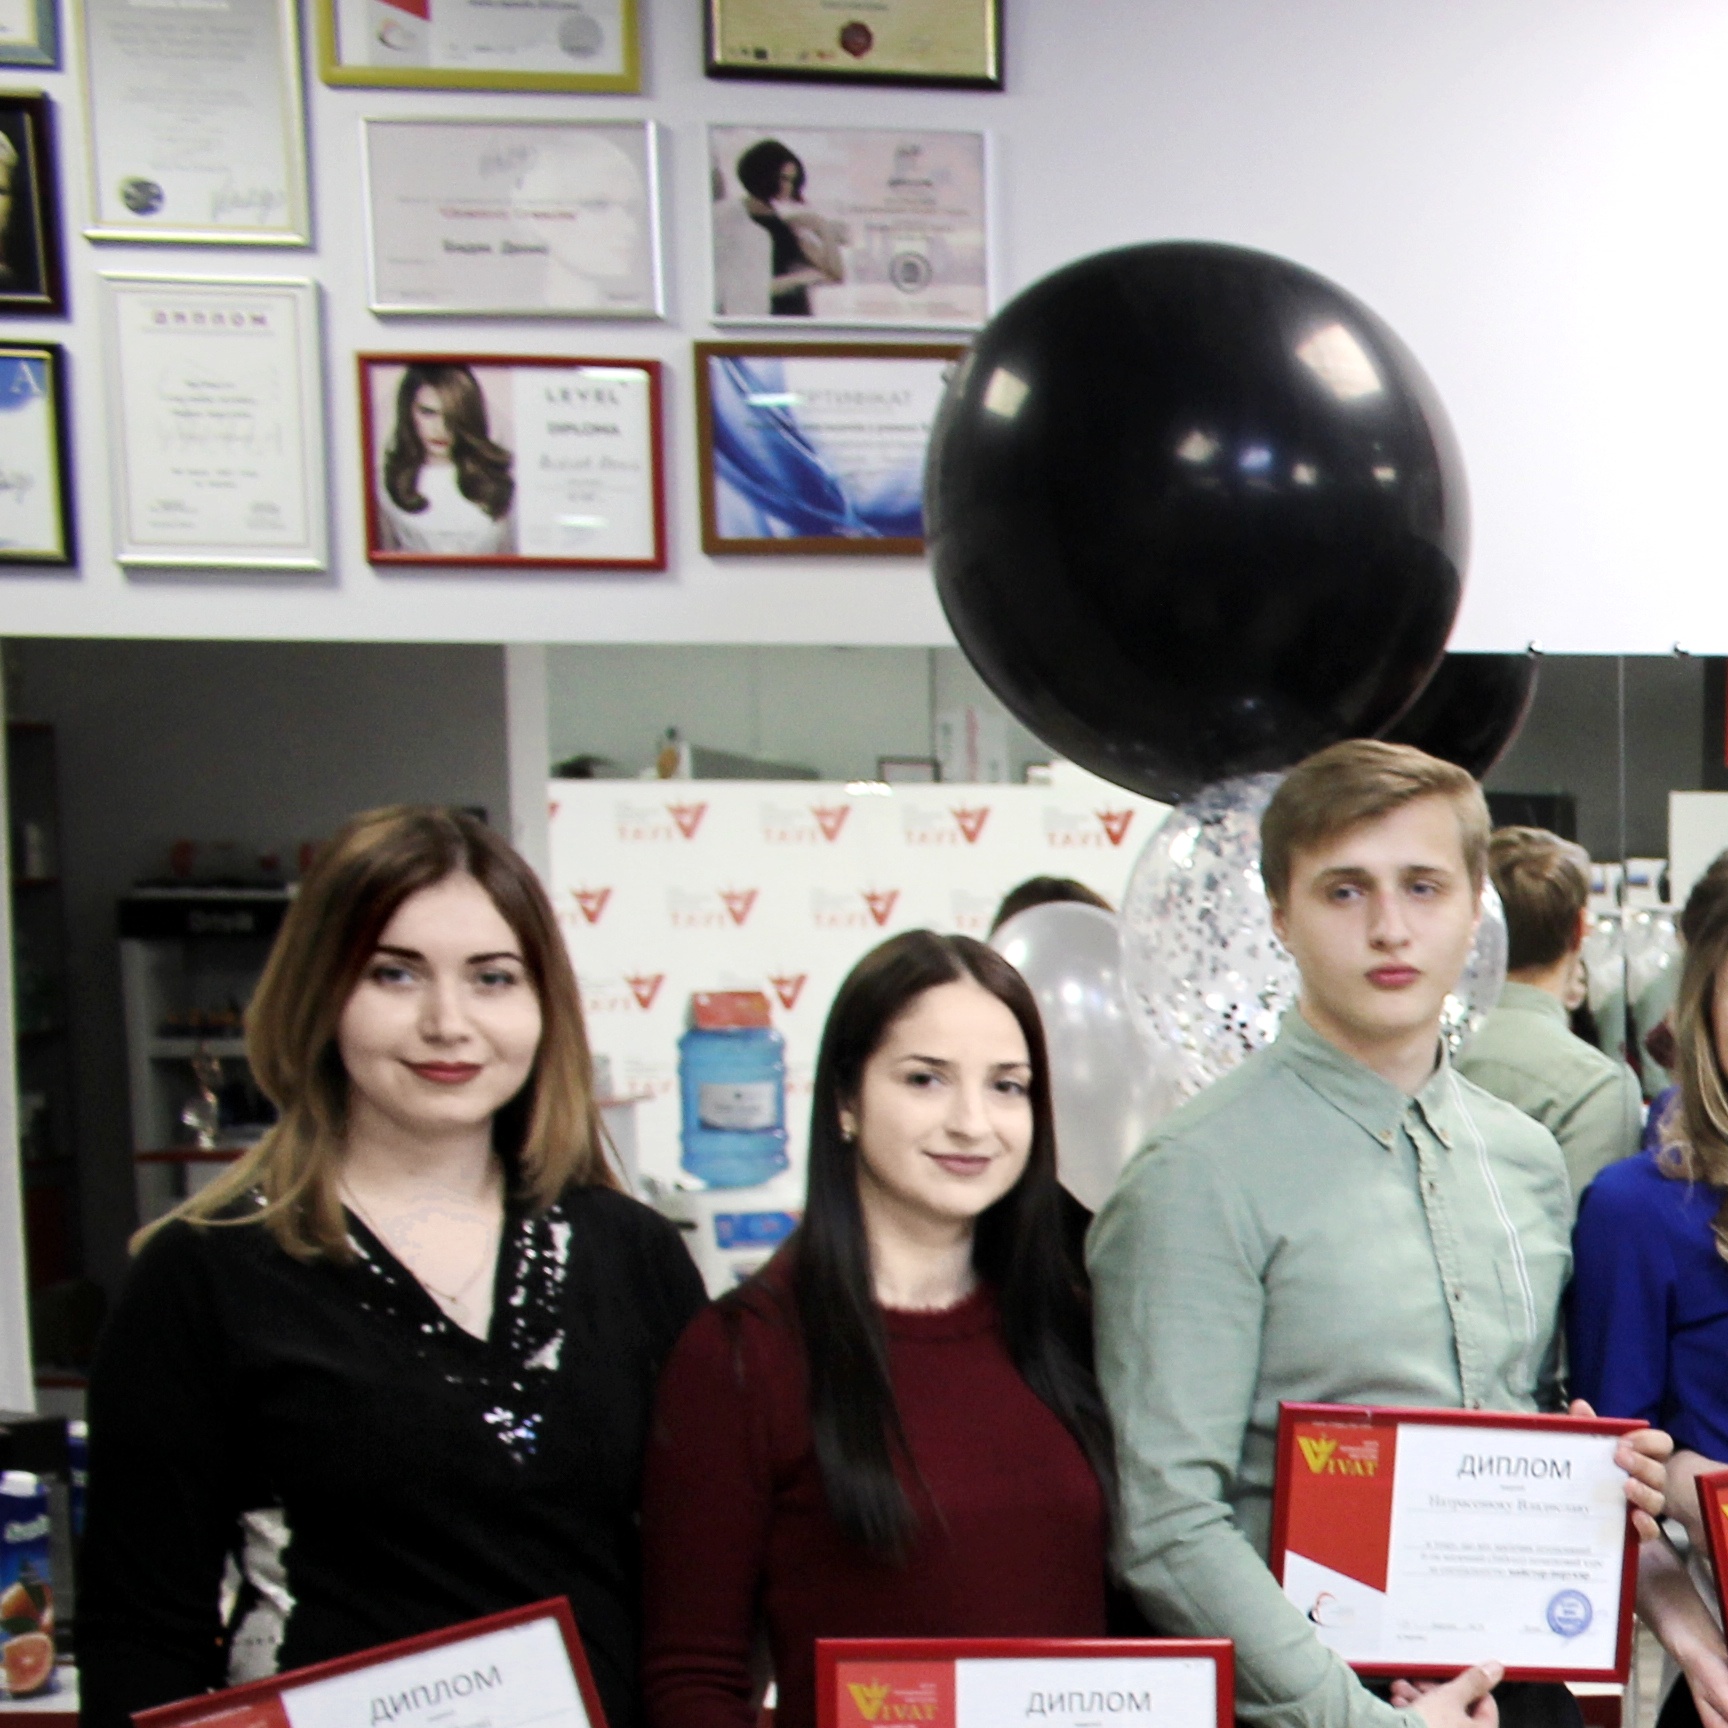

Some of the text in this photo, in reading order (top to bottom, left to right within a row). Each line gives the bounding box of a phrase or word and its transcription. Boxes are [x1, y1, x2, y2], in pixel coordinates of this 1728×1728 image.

[1456, 1454, 1573, 1481] ДИПЛОМ
[368, 1664, 505, 1728] ДИПЛОМ
[1024, 1690, 1153, 1718] ДИПЛОМ
